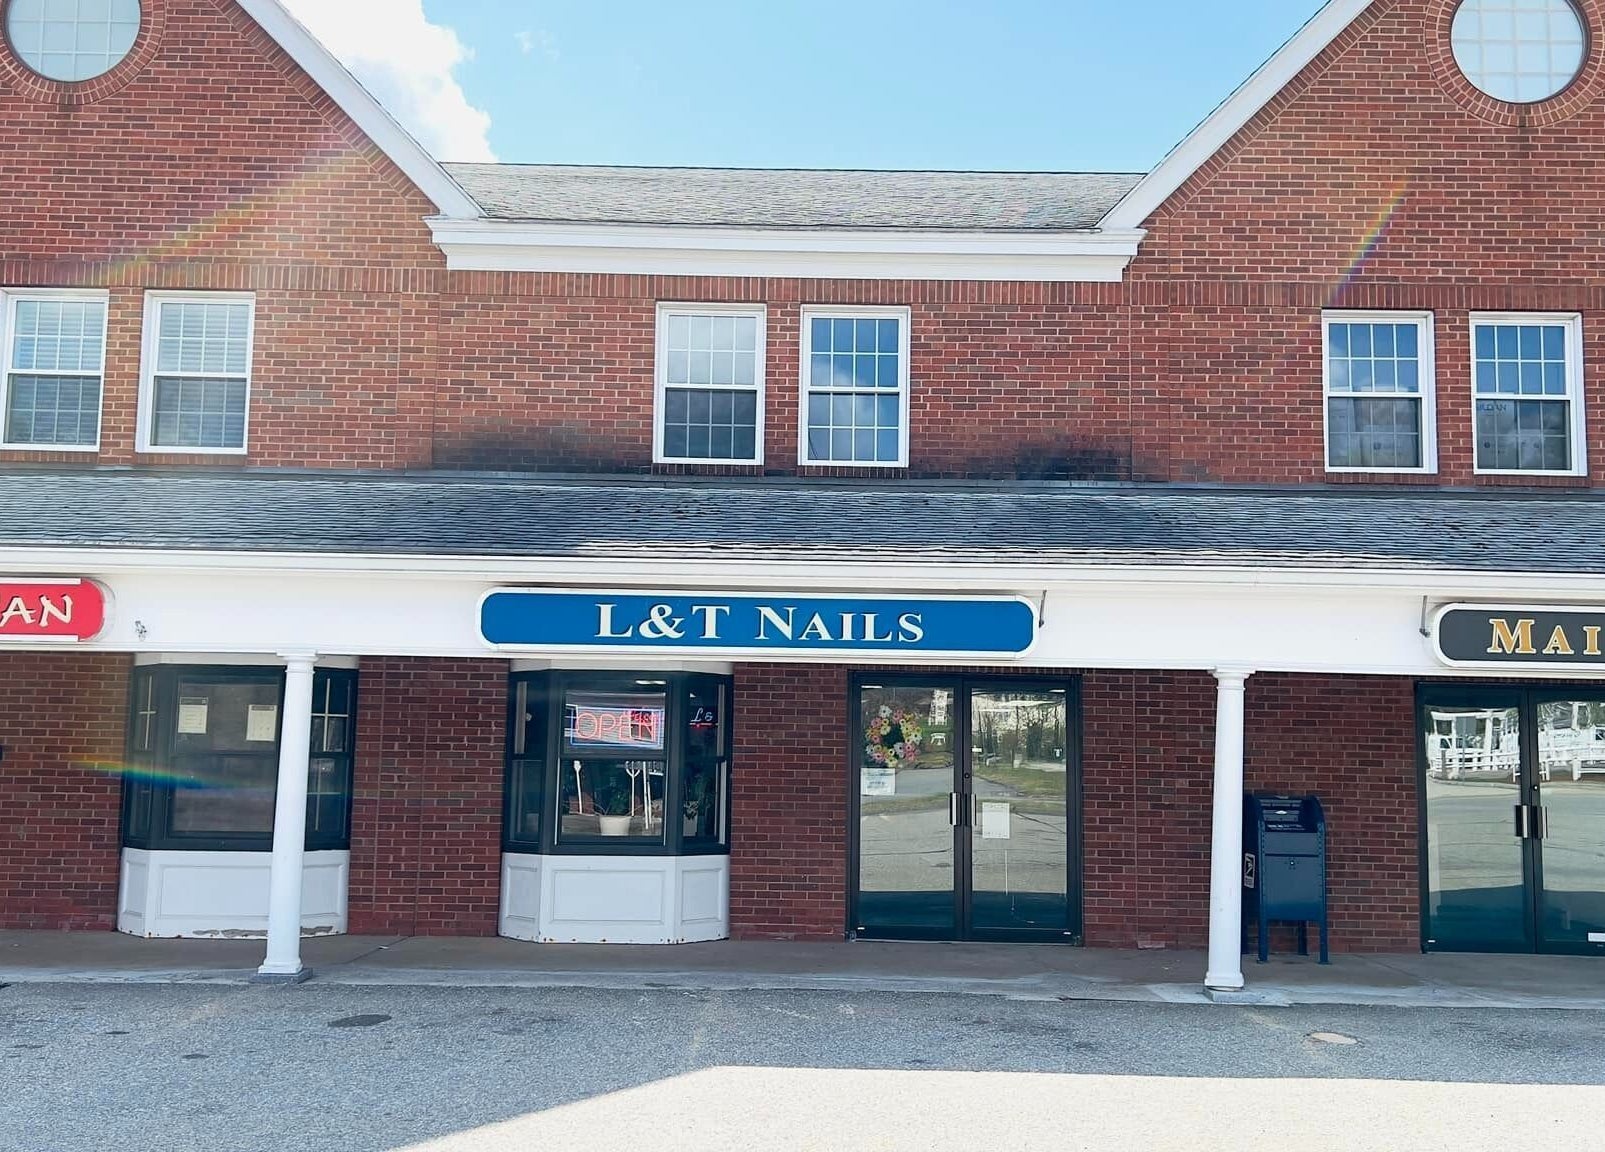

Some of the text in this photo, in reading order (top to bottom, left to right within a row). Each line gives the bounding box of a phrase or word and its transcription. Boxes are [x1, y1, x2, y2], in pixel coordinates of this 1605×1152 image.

[594, 603, 924, 642] L&T NAILS
[1487, 619, 1601, 655] MAI
[575, 711, 657, 743] OPEN
